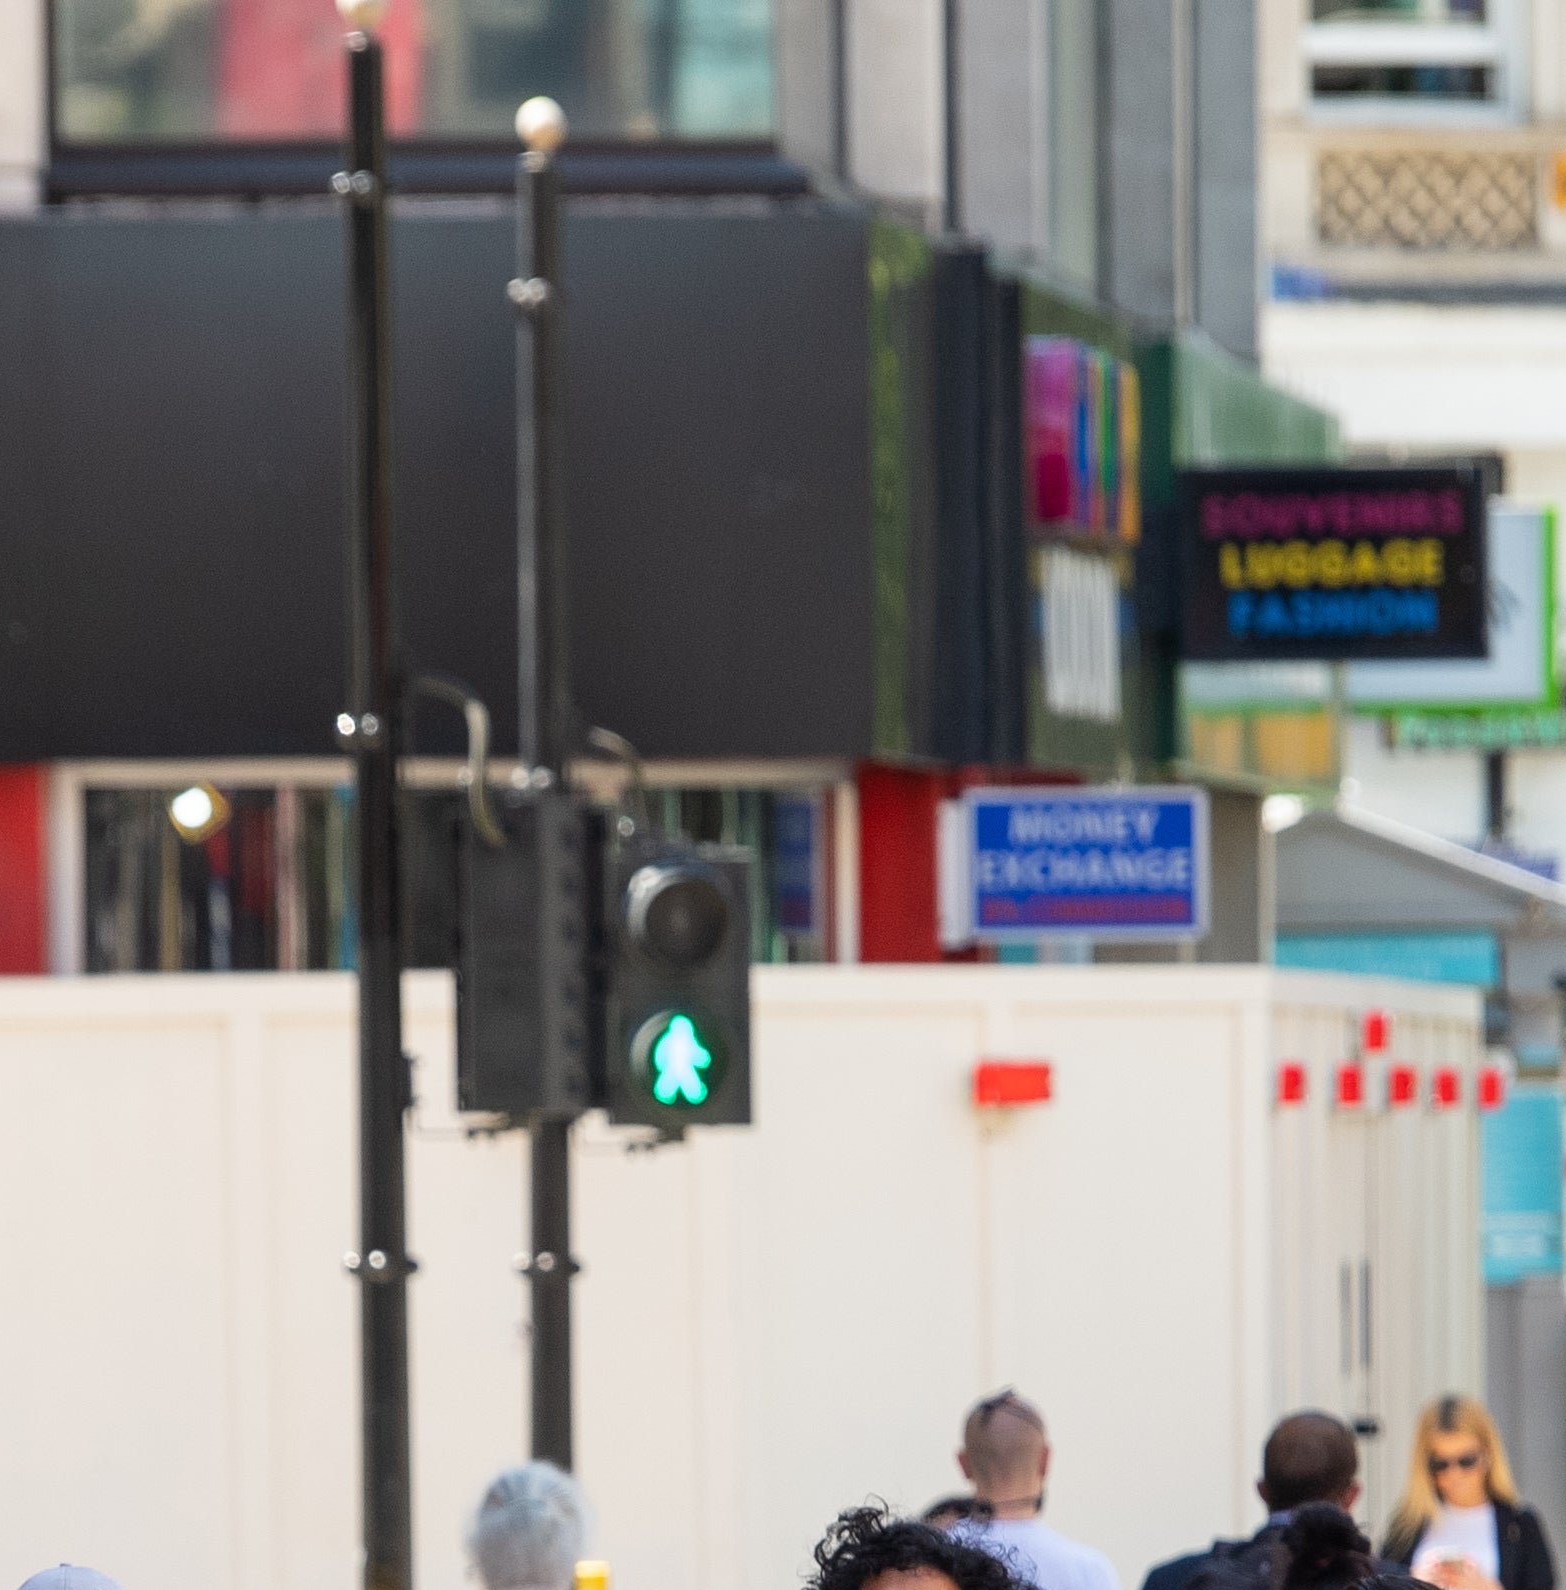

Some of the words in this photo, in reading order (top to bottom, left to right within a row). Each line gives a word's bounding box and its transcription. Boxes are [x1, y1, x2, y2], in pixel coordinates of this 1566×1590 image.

[1199, 491, 1464, 540] SOUVENIRS
[1219, 539, 1444, 589] LUGGAGE
[1227, 588, 1438, 637] FASHION
[1008, 804, 1160, 849] MONEY
[974, 850, 1194, 891] EXCHANGE
